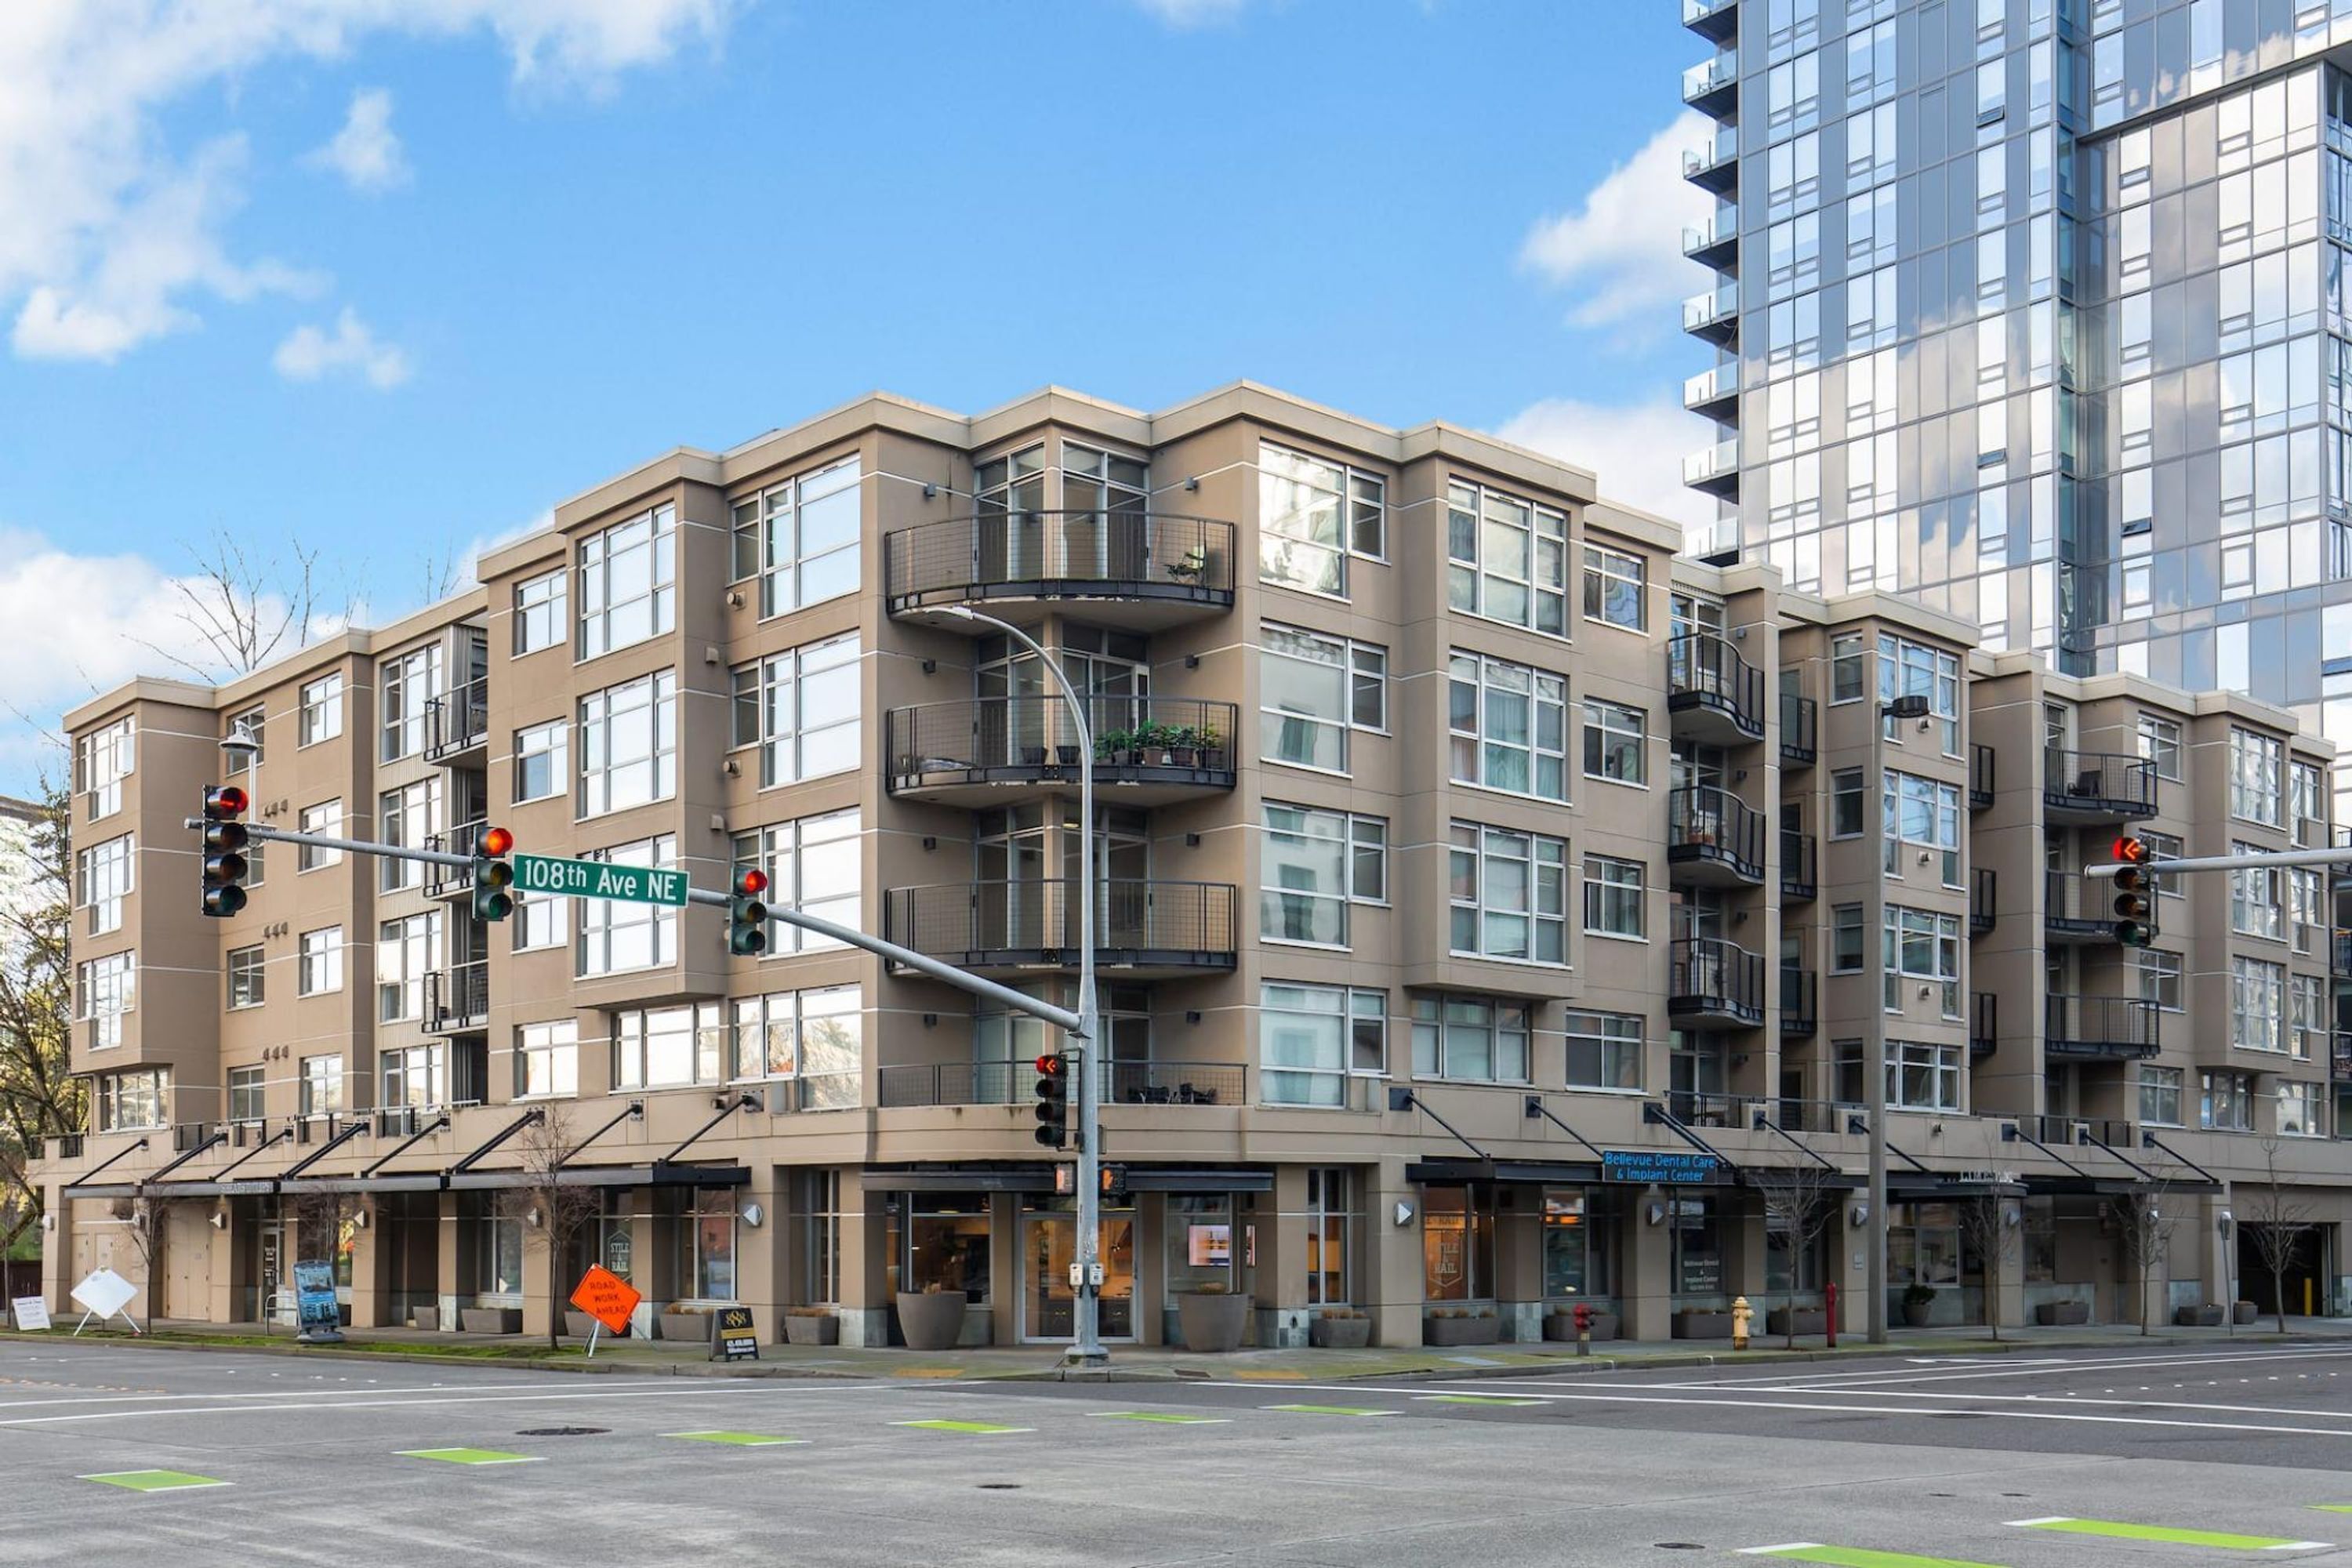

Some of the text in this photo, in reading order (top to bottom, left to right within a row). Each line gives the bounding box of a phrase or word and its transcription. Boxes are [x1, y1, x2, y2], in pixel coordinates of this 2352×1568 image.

[524, 859, 677, 901] 108th Ave NE
[1606, 1152, 1715, 1167] Bellevue Dental Care
[1617, 1168, 1704, 1181] & Implant Center
[611, 1243, 630, 1253] STILE
[611, 1261, 629, 1272] RAIL
[589, 1280, 615, 1290] ROAD
[593, 1292, 620, 1303] WORK
[596, 1305, 628, 1315] AHEAD
